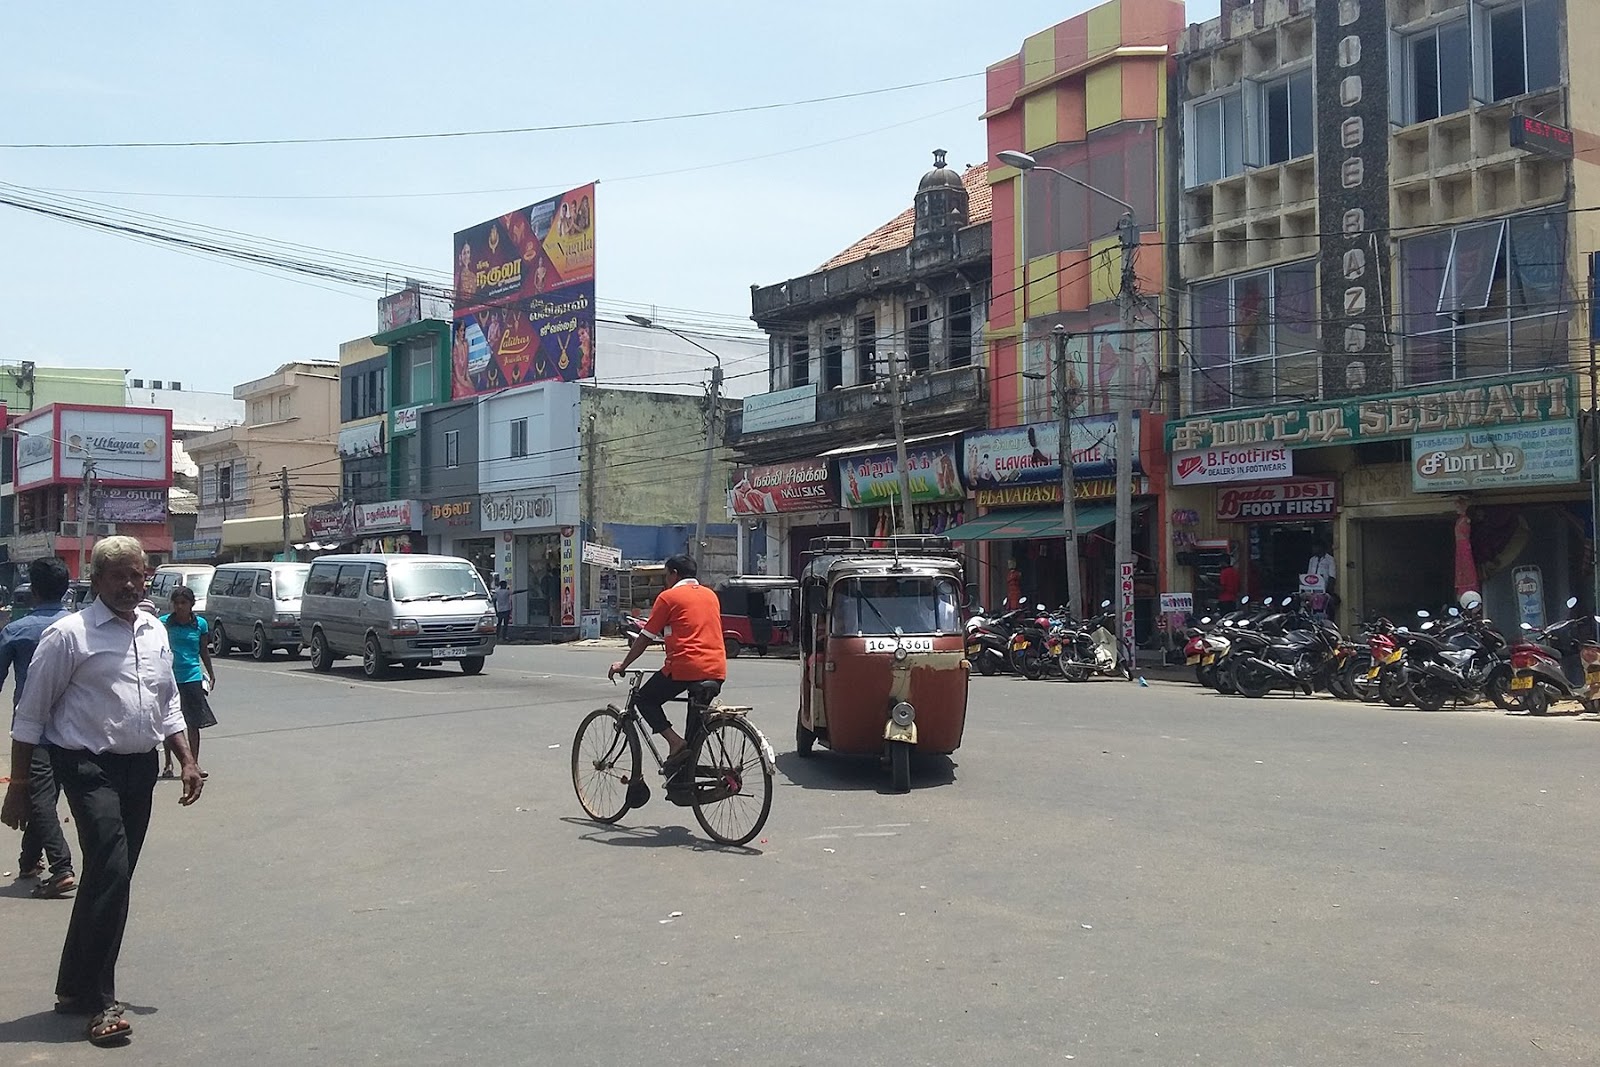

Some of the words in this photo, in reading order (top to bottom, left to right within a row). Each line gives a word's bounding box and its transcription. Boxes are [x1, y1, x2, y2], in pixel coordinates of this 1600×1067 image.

[476, 258, 522, 288] நகுலா
[1359, 377, 1571, 437] SEEMATI
[93, 437, 140, 452] Uthayaa
[906, 451, 931, 471] ல்க்
[1207, 448, 1286, 467] B.FootFirst
[803, 484, 826, 497] SILKS
[870, 479, 900, 497] VIJAY
[908, 476, 930, 493] ILK
[978, 484, 1057, 506] ELAVARASI
[1218, 486, 1277, 516] Bata
[1283, 483, 1330, 499] DSI
[1242, 502, 1282, 516] FOOT
[1286, 499, 1333, 514] FIRST
